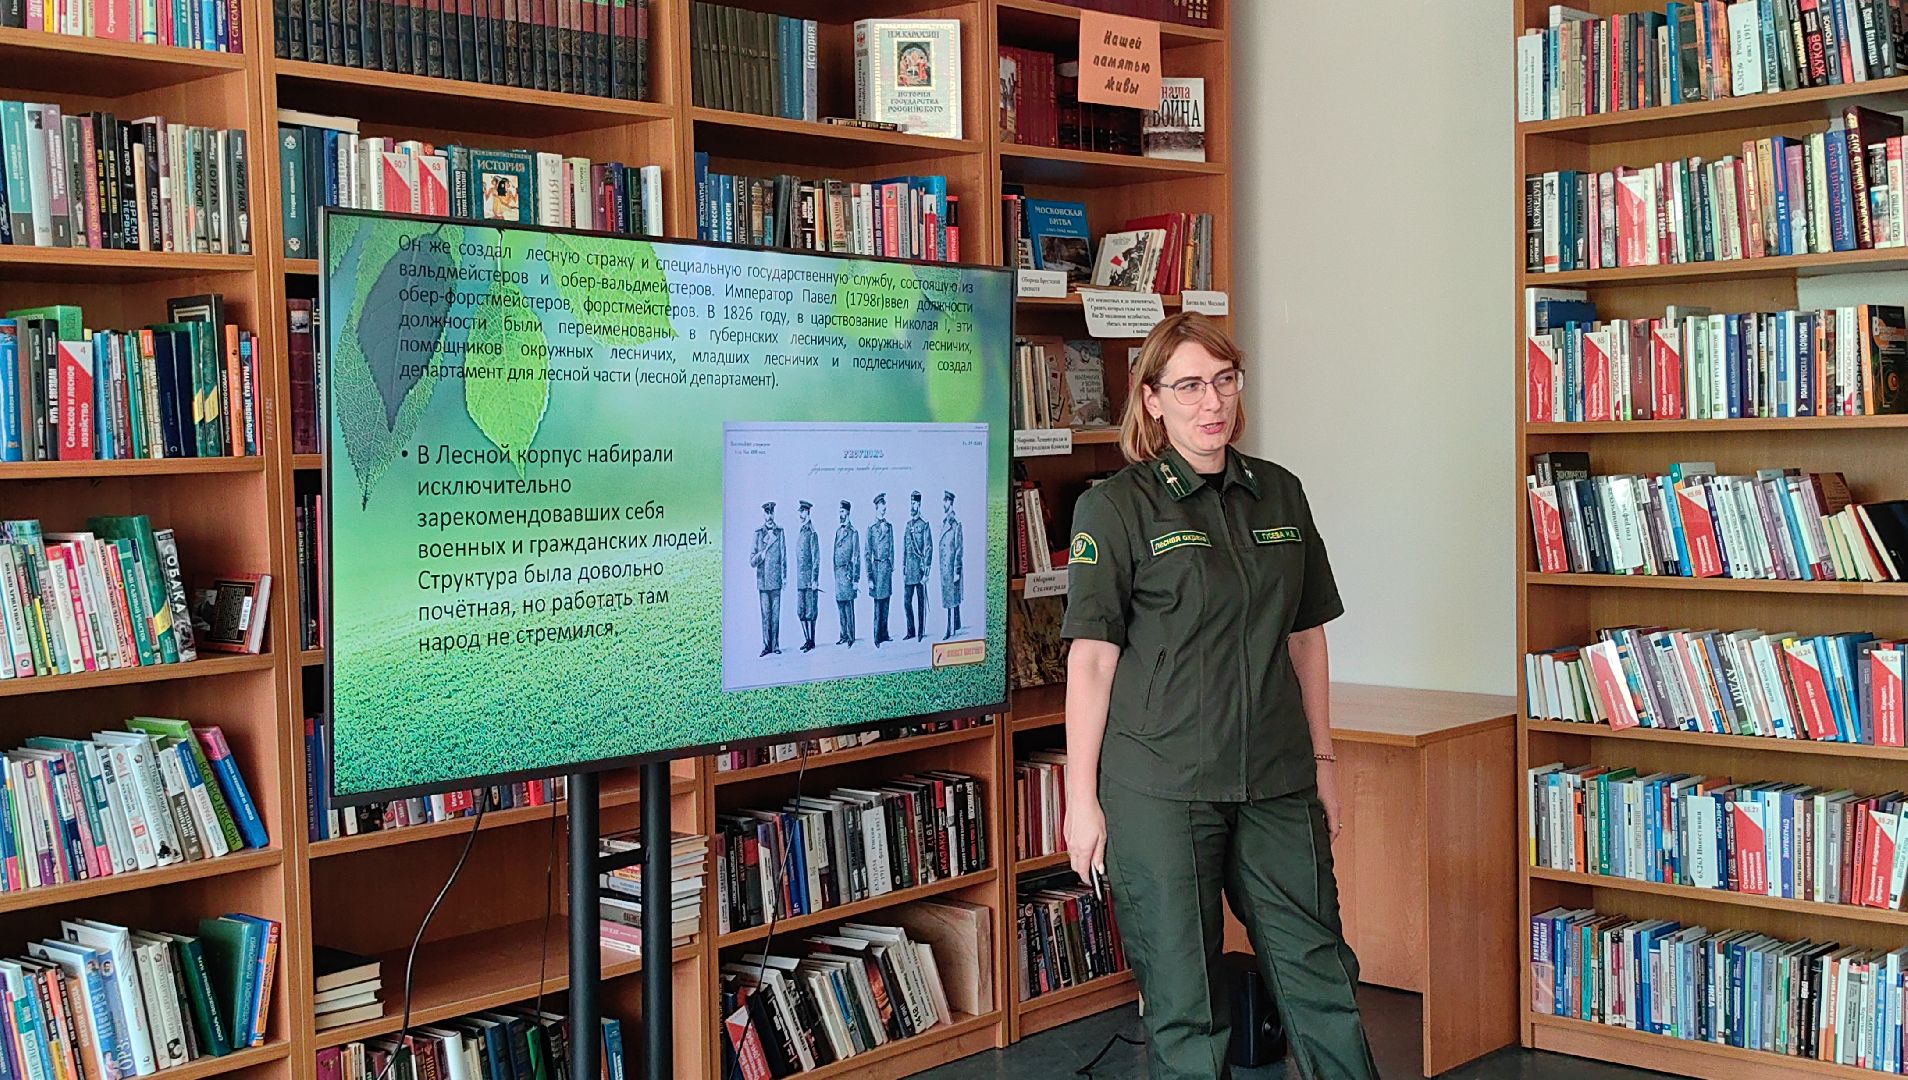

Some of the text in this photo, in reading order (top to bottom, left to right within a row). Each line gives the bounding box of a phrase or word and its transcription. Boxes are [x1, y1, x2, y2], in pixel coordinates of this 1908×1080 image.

[1103, 29, 1142, 50] Нашей
[1811, 33, 1825, 76] ЖУКОВ
[1093, 55, 1151, 75] памятью
[1104, 77, 1140, 95] живы
[1152, 95, 1201, 128] ВОЙНА
[1847, 133, 1860, 153] 2019
[476, 159, 525, 173] ИСТОРИЯ
[1532, 181, 1541, 227] КОЖЕДУБ
[123, 200, 131, 243] ПЕРВЫХ
[130, 200, 138, 244] ВРЕМЯ
[1049, 217, 1072, 226] БИТВА
[399, 234, 974, 295] Он же создал лесную стражу и специальную государственную службу, состоящую из
[399, 263, 529, 286] вальдмейстеров
[540, 274, 549, 284] и
[561, 273, 715, 299] обер-вальдмейстеров.
[725, 284, 793, 305] Император
[802, 289, 837, 305] Павел
[917, 298, 973, 315] должности
[399, 288, 575, 314] обер-форстмейстеров,
[583, 299, 699, 323] форстмейстеров.
[707, 304, 716, 319] В
[723, 305, 753, 321] 1826
[760, 311, 790, 327] году,
[797, 314, 804, 325] в
[811, 313, 888, 332] царствование
[895, 317, 938, 332] Николая
[956, 322, 973, 333] эти
[398, 311, 972, 355] должности были переименованы, в губернских лесничих, окружных лесничих,
[400, 338, 972, 374] помощников окружных лесничих, младших лесничих и подлесничих, создал
[65, 365, 76, 398] лесное
[400, 363, 779, 390] департамент для лесной части (лесной департамент).
[65, 407, 76, 448] Сельское
[79, 402, 90, 448] хозяйство
[418, 443, 673, 470] В Лесной корпус набирали
[417, 477, 572, 496] исключительно
[417, 500, 664, 531] зарекомендовавших себя
[418, 526, 713, 559] военных и гражданских людей.
[164, 544, 187, 614] СОБАКА
[418, 560, 664, 594] Структура была довольно
[418, 588, 670, 622] почётная, но работать там
[418, 632, 481, 655] народ
[487, 628, 510, 646] не
[1725, 667, 1744, 708] АУДИТ
[939, 831, 948, 870] КАЗАКИ
